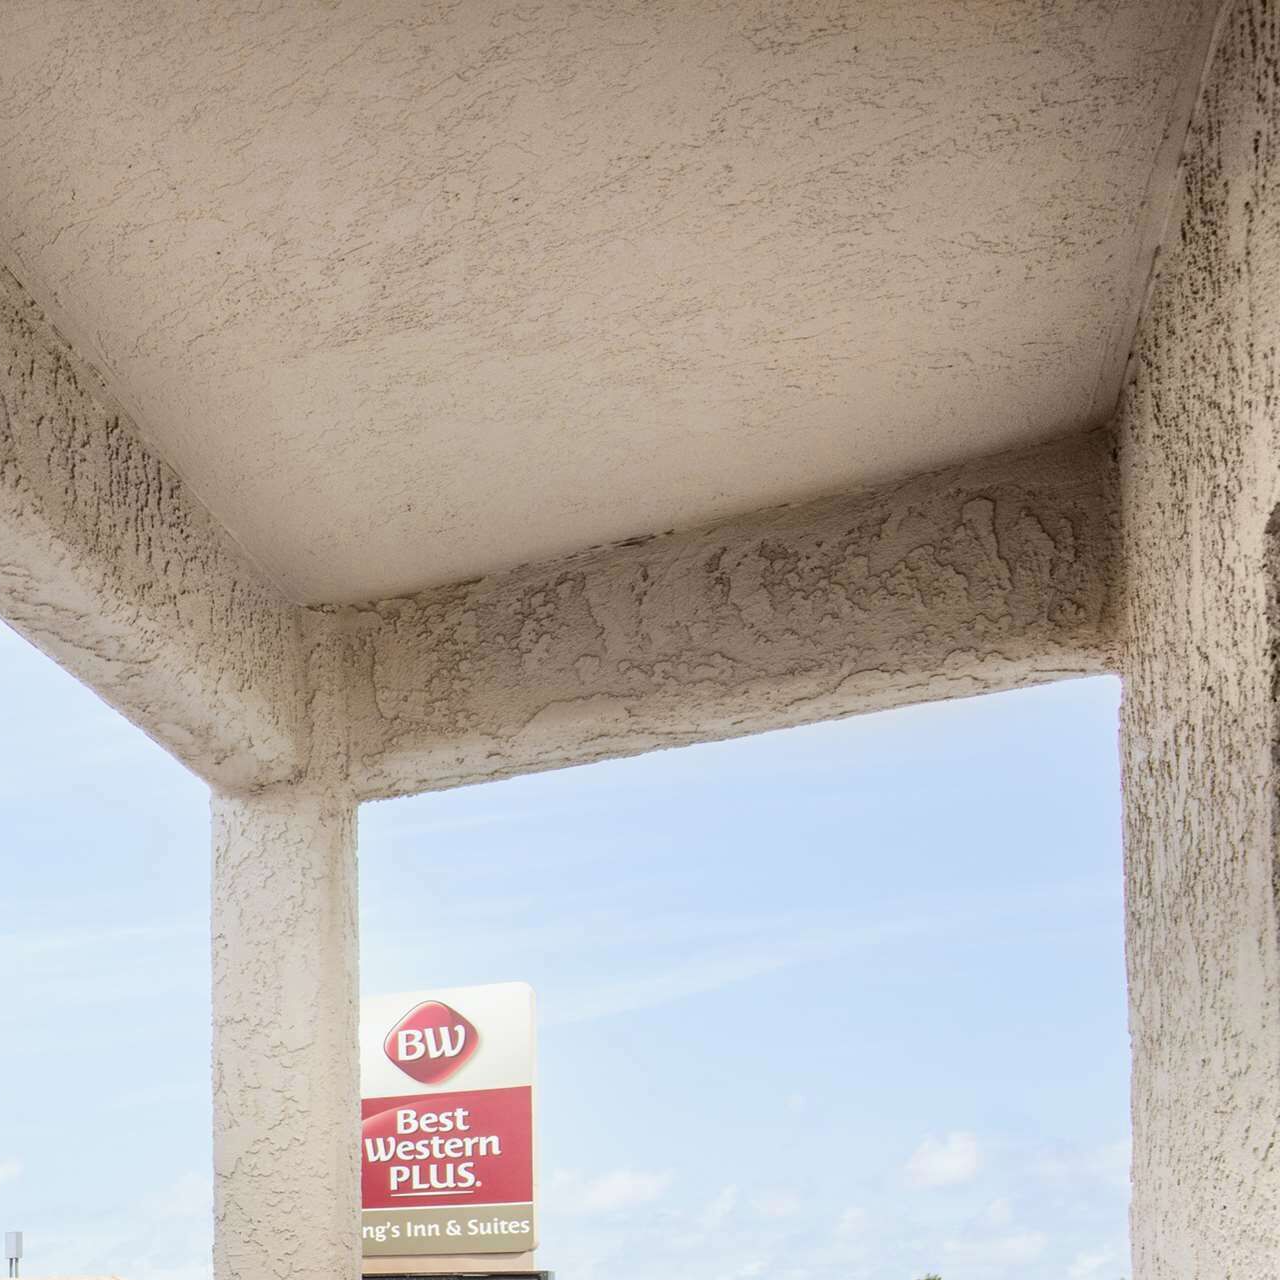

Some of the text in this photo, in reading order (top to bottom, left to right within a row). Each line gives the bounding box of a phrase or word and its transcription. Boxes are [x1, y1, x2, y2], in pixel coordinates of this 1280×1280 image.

[397, 1024, 466, 1062] BW
[396, 1107, 471, 1135] Best
[364, 1134, 503, 1163] Western
[407, 1221, 441, 1238] Inn
[445, 1219, 463, 1237] &
[467, 1217, 531, 1236] Suites
